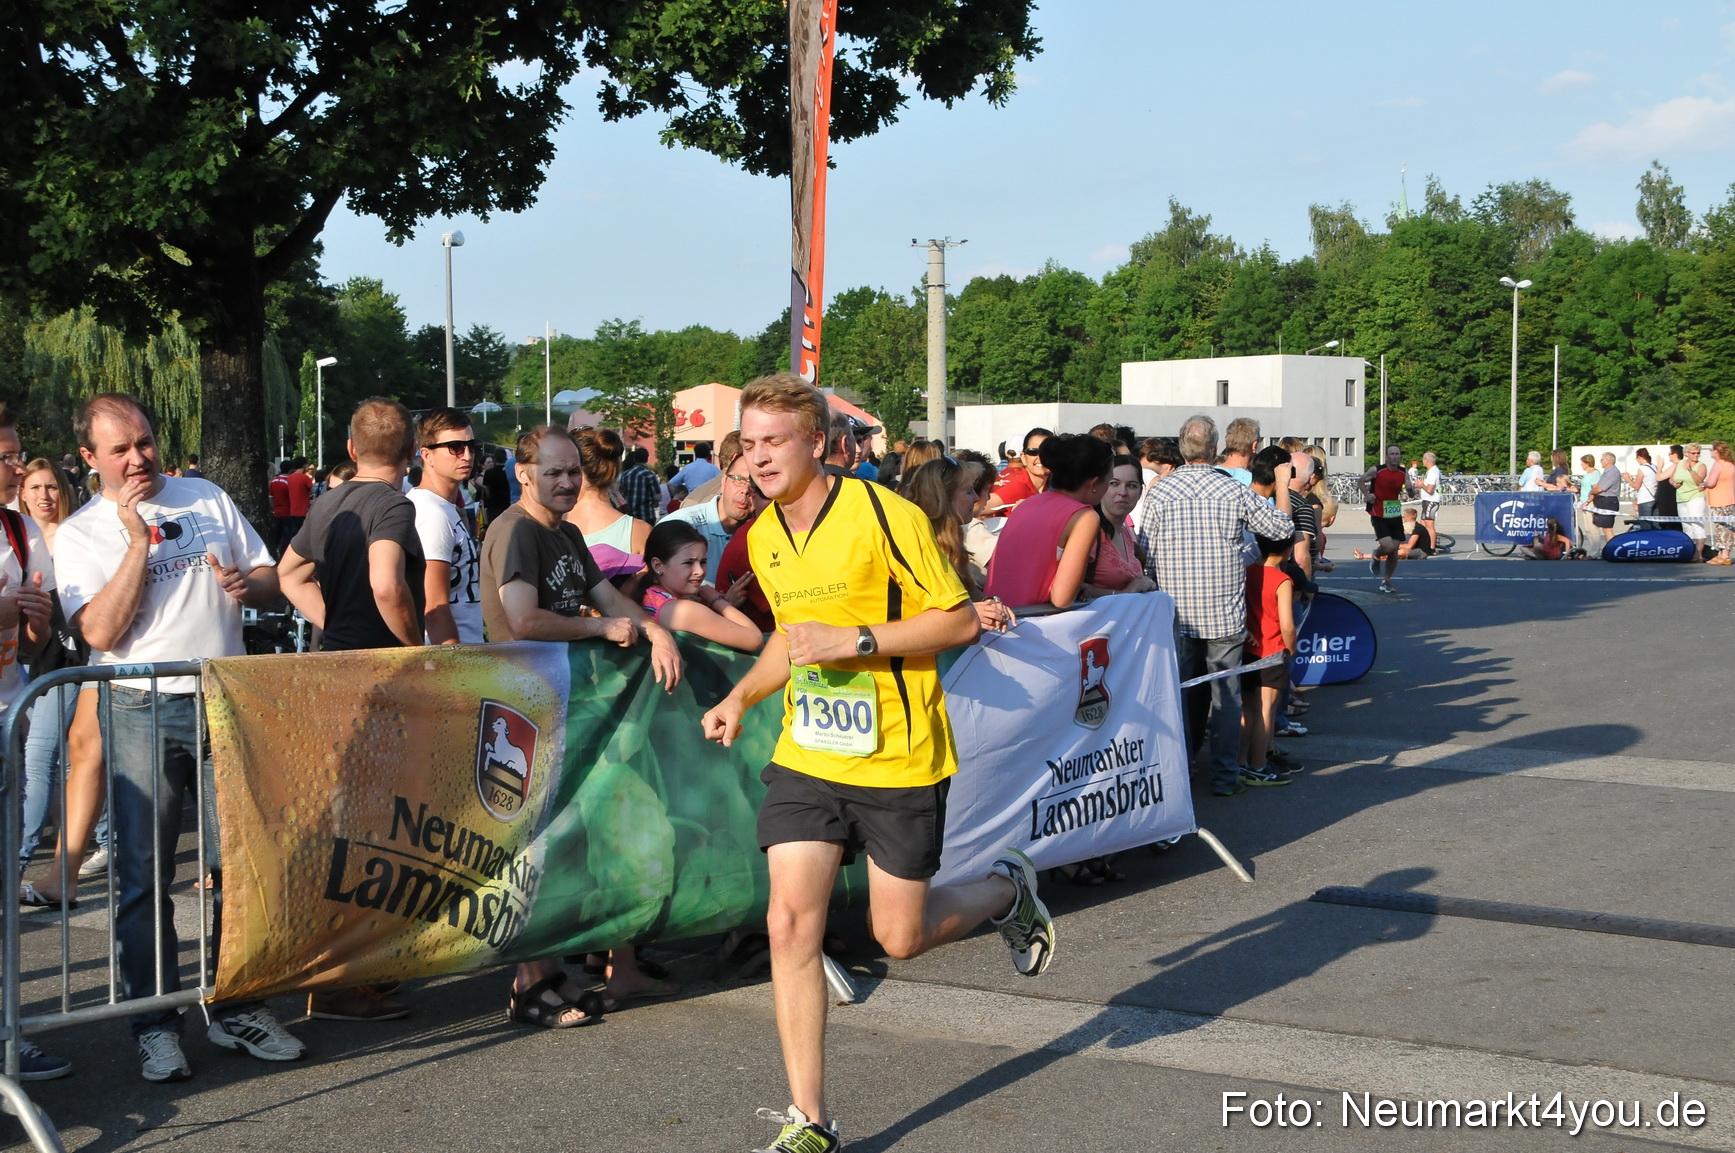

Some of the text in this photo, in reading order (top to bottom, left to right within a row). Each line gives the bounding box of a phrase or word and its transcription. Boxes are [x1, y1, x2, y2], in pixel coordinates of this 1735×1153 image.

[1384, 505, 1401, 514] 1200
[1626, 546, 1684, 558] Fischer
[782, 582, 847, 602] SPANGLER
[810, 592, 849, 604] AUTOMATION
[796, 694, 873, 734] 1300
[1081, 706, 1104, 722] 1628
[1046, 737, 1145, 788] Neumarkter
[488, 786, 514, 811] 1628
[1030, 766, 1164, 841] Lammsbräu
[389, 795, 539, 899] Neumarkte
[324, 837, 529, 950] Lammsbr
